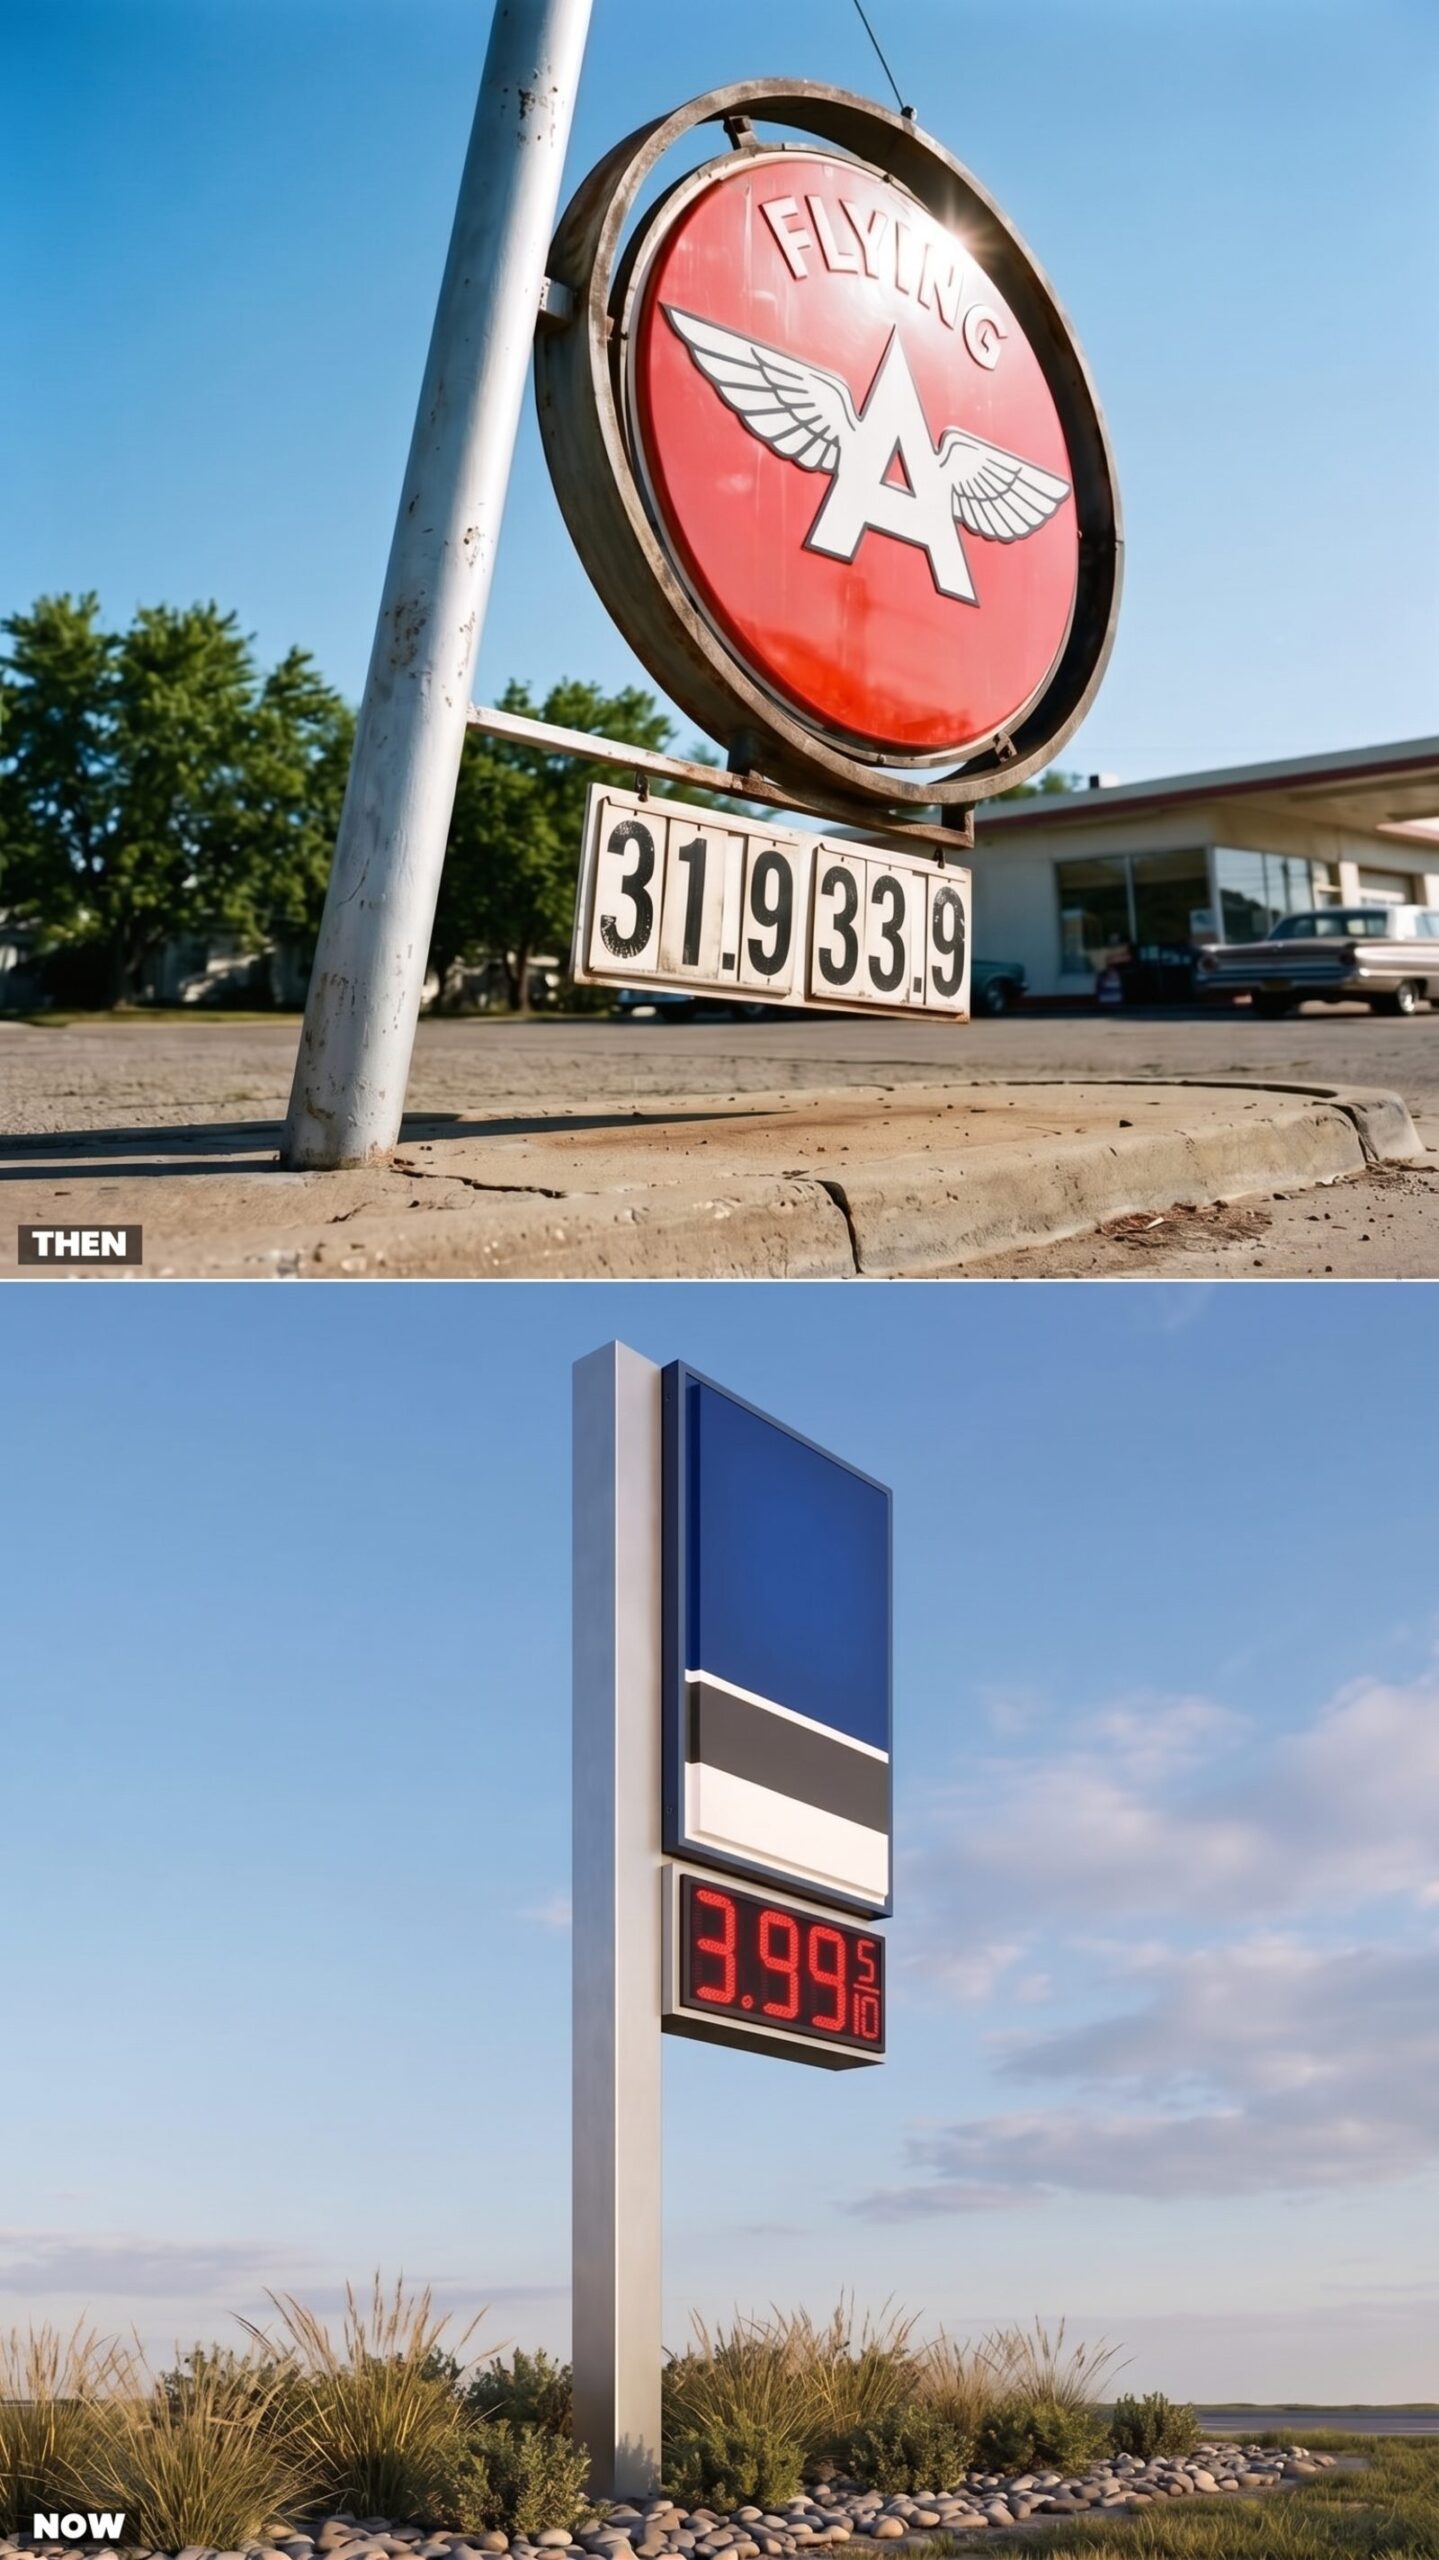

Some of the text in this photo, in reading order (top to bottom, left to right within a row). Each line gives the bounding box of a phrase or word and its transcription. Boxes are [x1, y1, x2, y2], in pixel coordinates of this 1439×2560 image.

[759, 195, 1008, 371] FLYING
[802, 323, 980, 608] A
[600, 819, 966, 998] 31.9 33.9
[696, 1889, 846, 2031] 3.99
